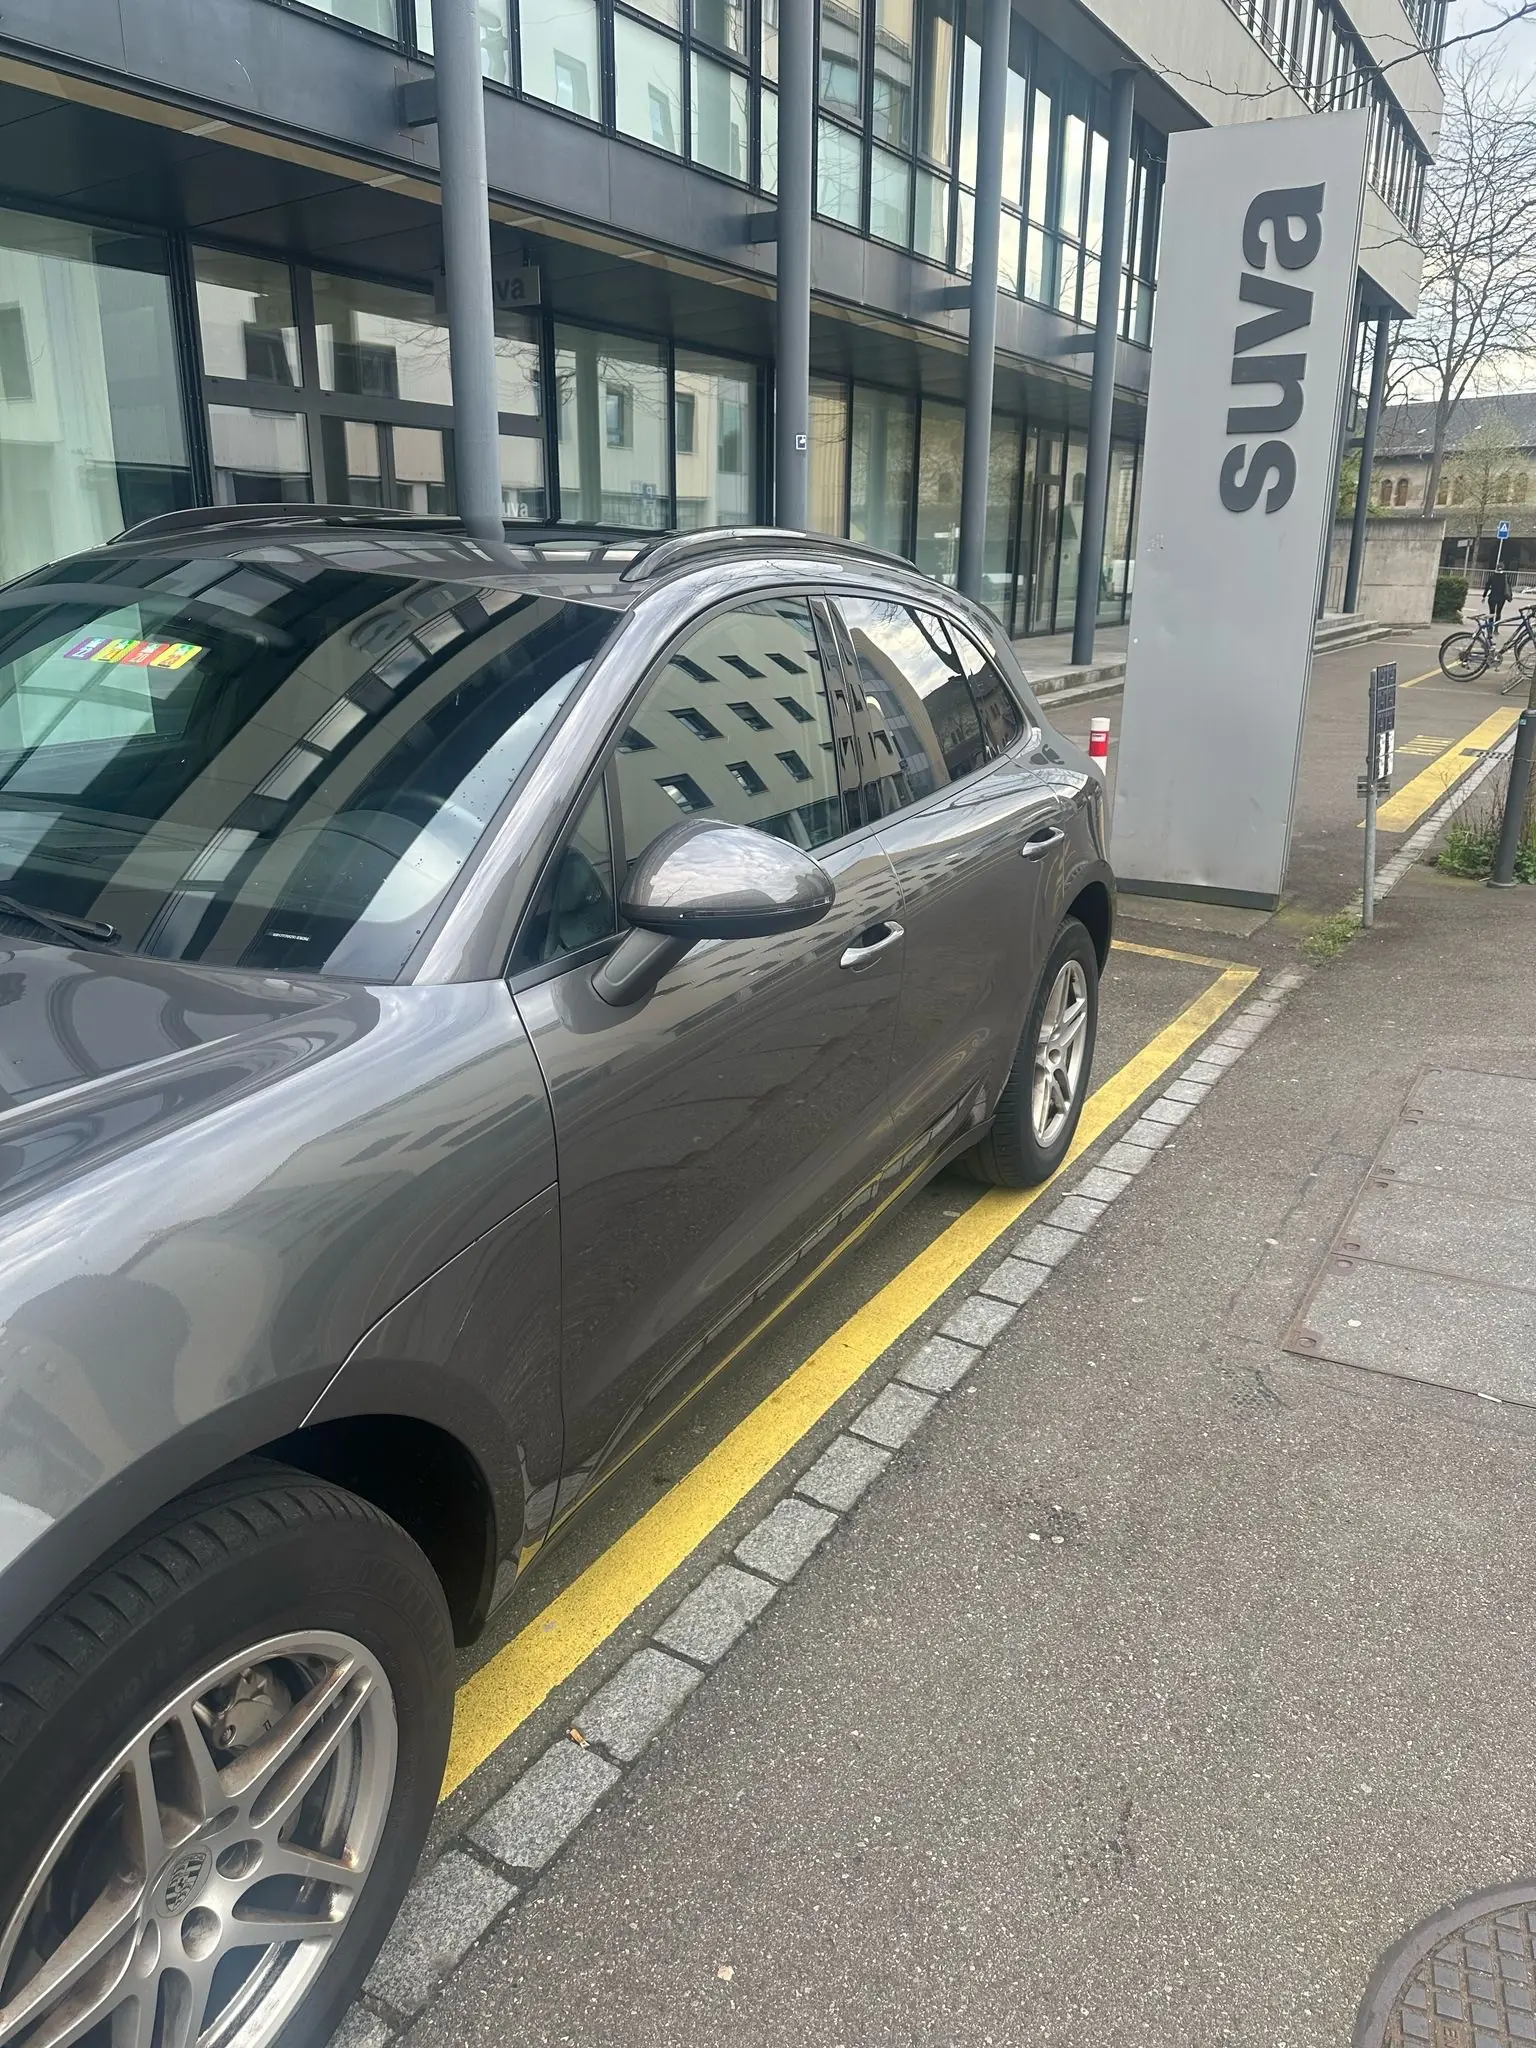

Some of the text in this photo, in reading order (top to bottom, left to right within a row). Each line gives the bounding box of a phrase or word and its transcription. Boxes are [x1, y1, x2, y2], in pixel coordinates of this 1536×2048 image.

[495, 277, 526, 301] va
[1219, 178, 1326, 515] suva
[502, 502, 529, 518] uva
